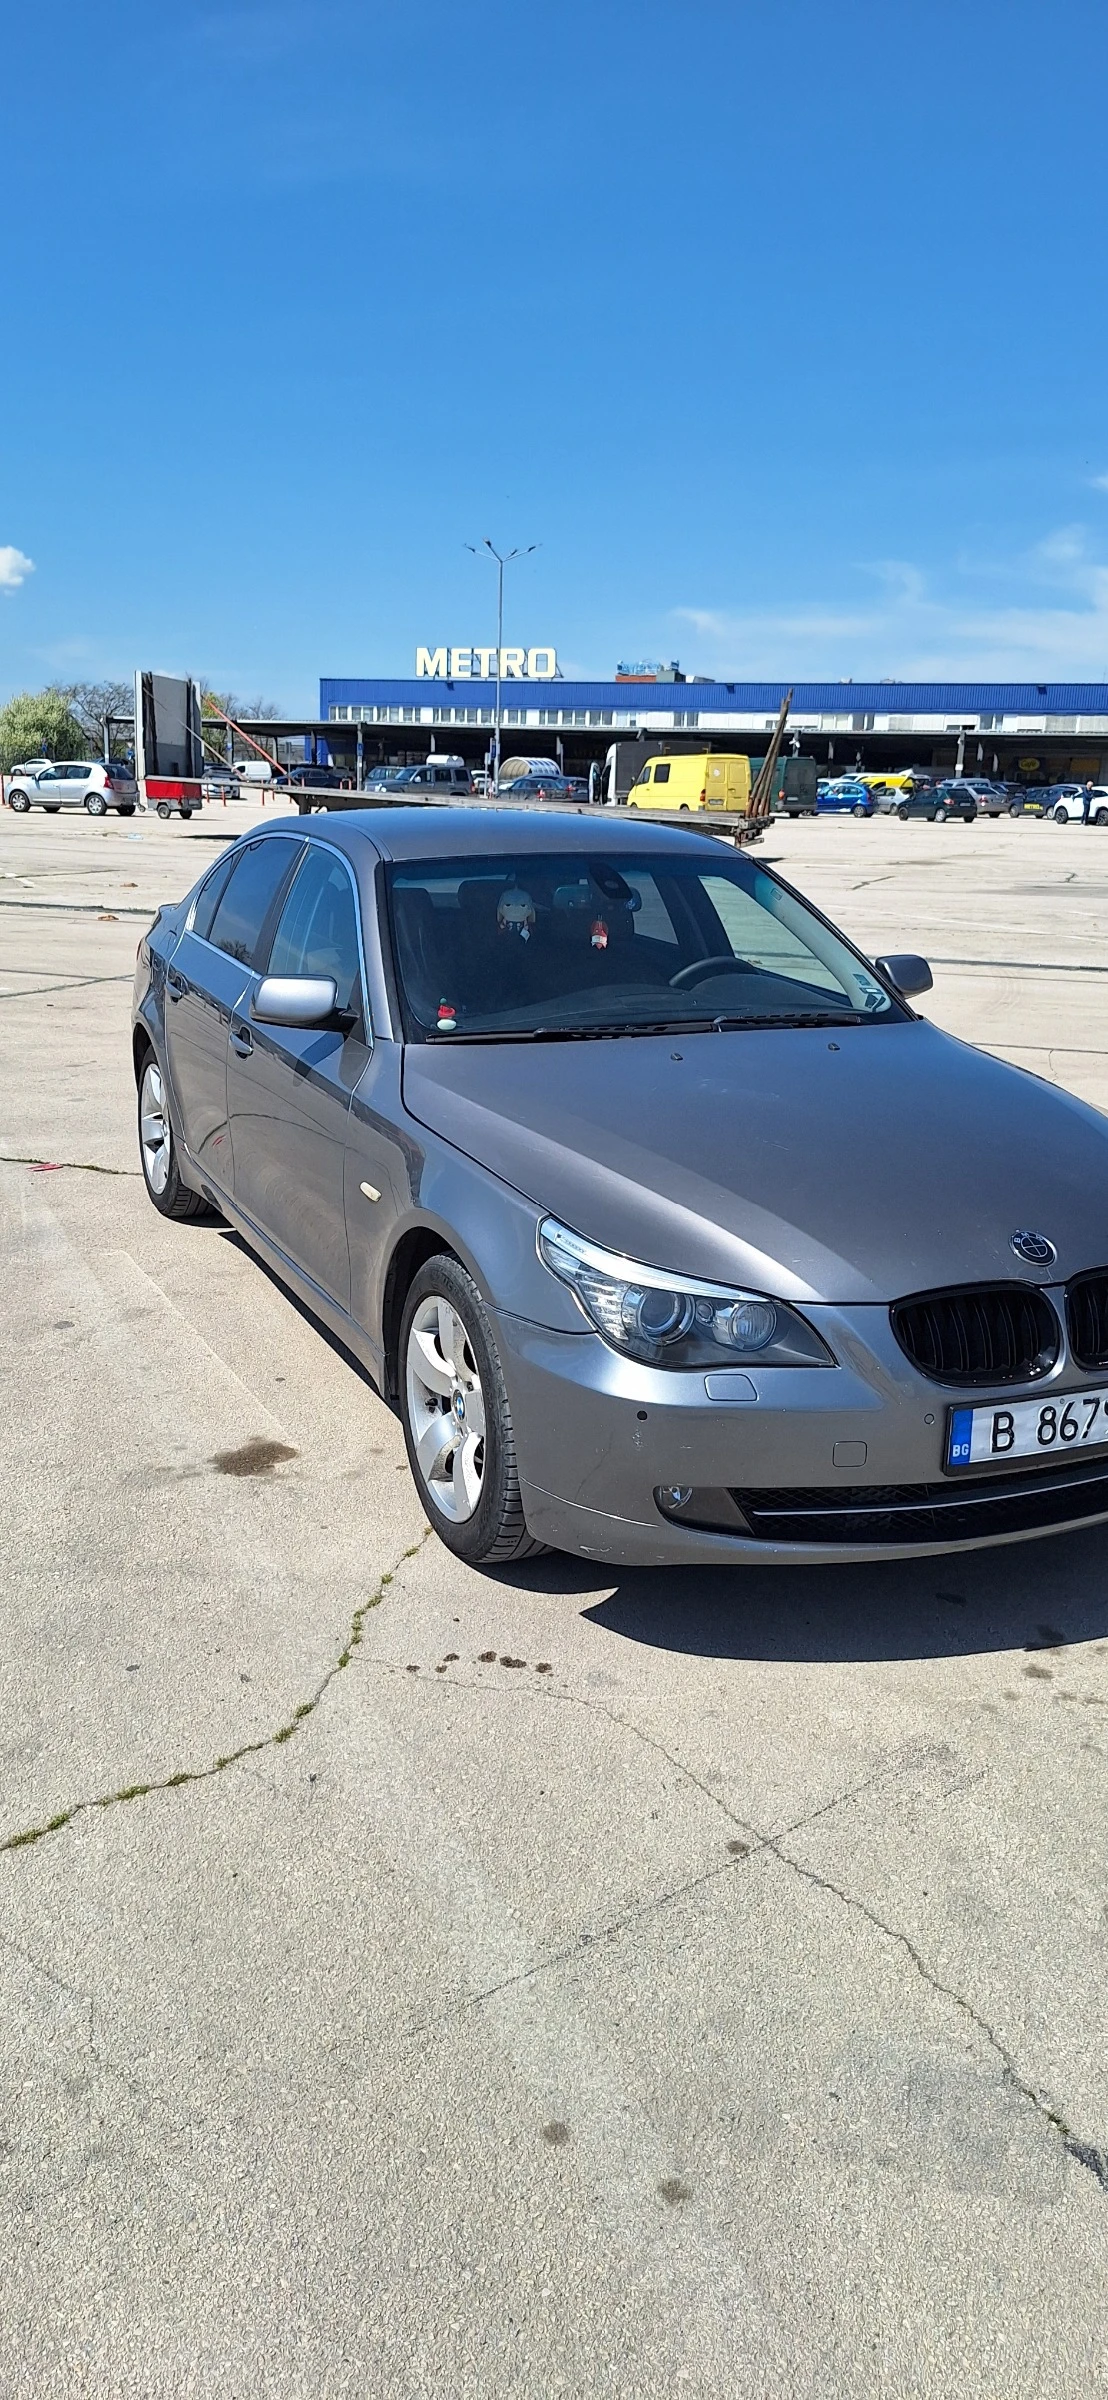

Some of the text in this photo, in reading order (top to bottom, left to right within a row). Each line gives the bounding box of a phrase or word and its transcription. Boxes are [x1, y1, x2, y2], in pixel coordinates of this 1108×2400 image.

[416, 647, 556, 678] METRO
[991, 1397, 1108, 1453] B 867
[952, 1443, 969, 1457] BG
